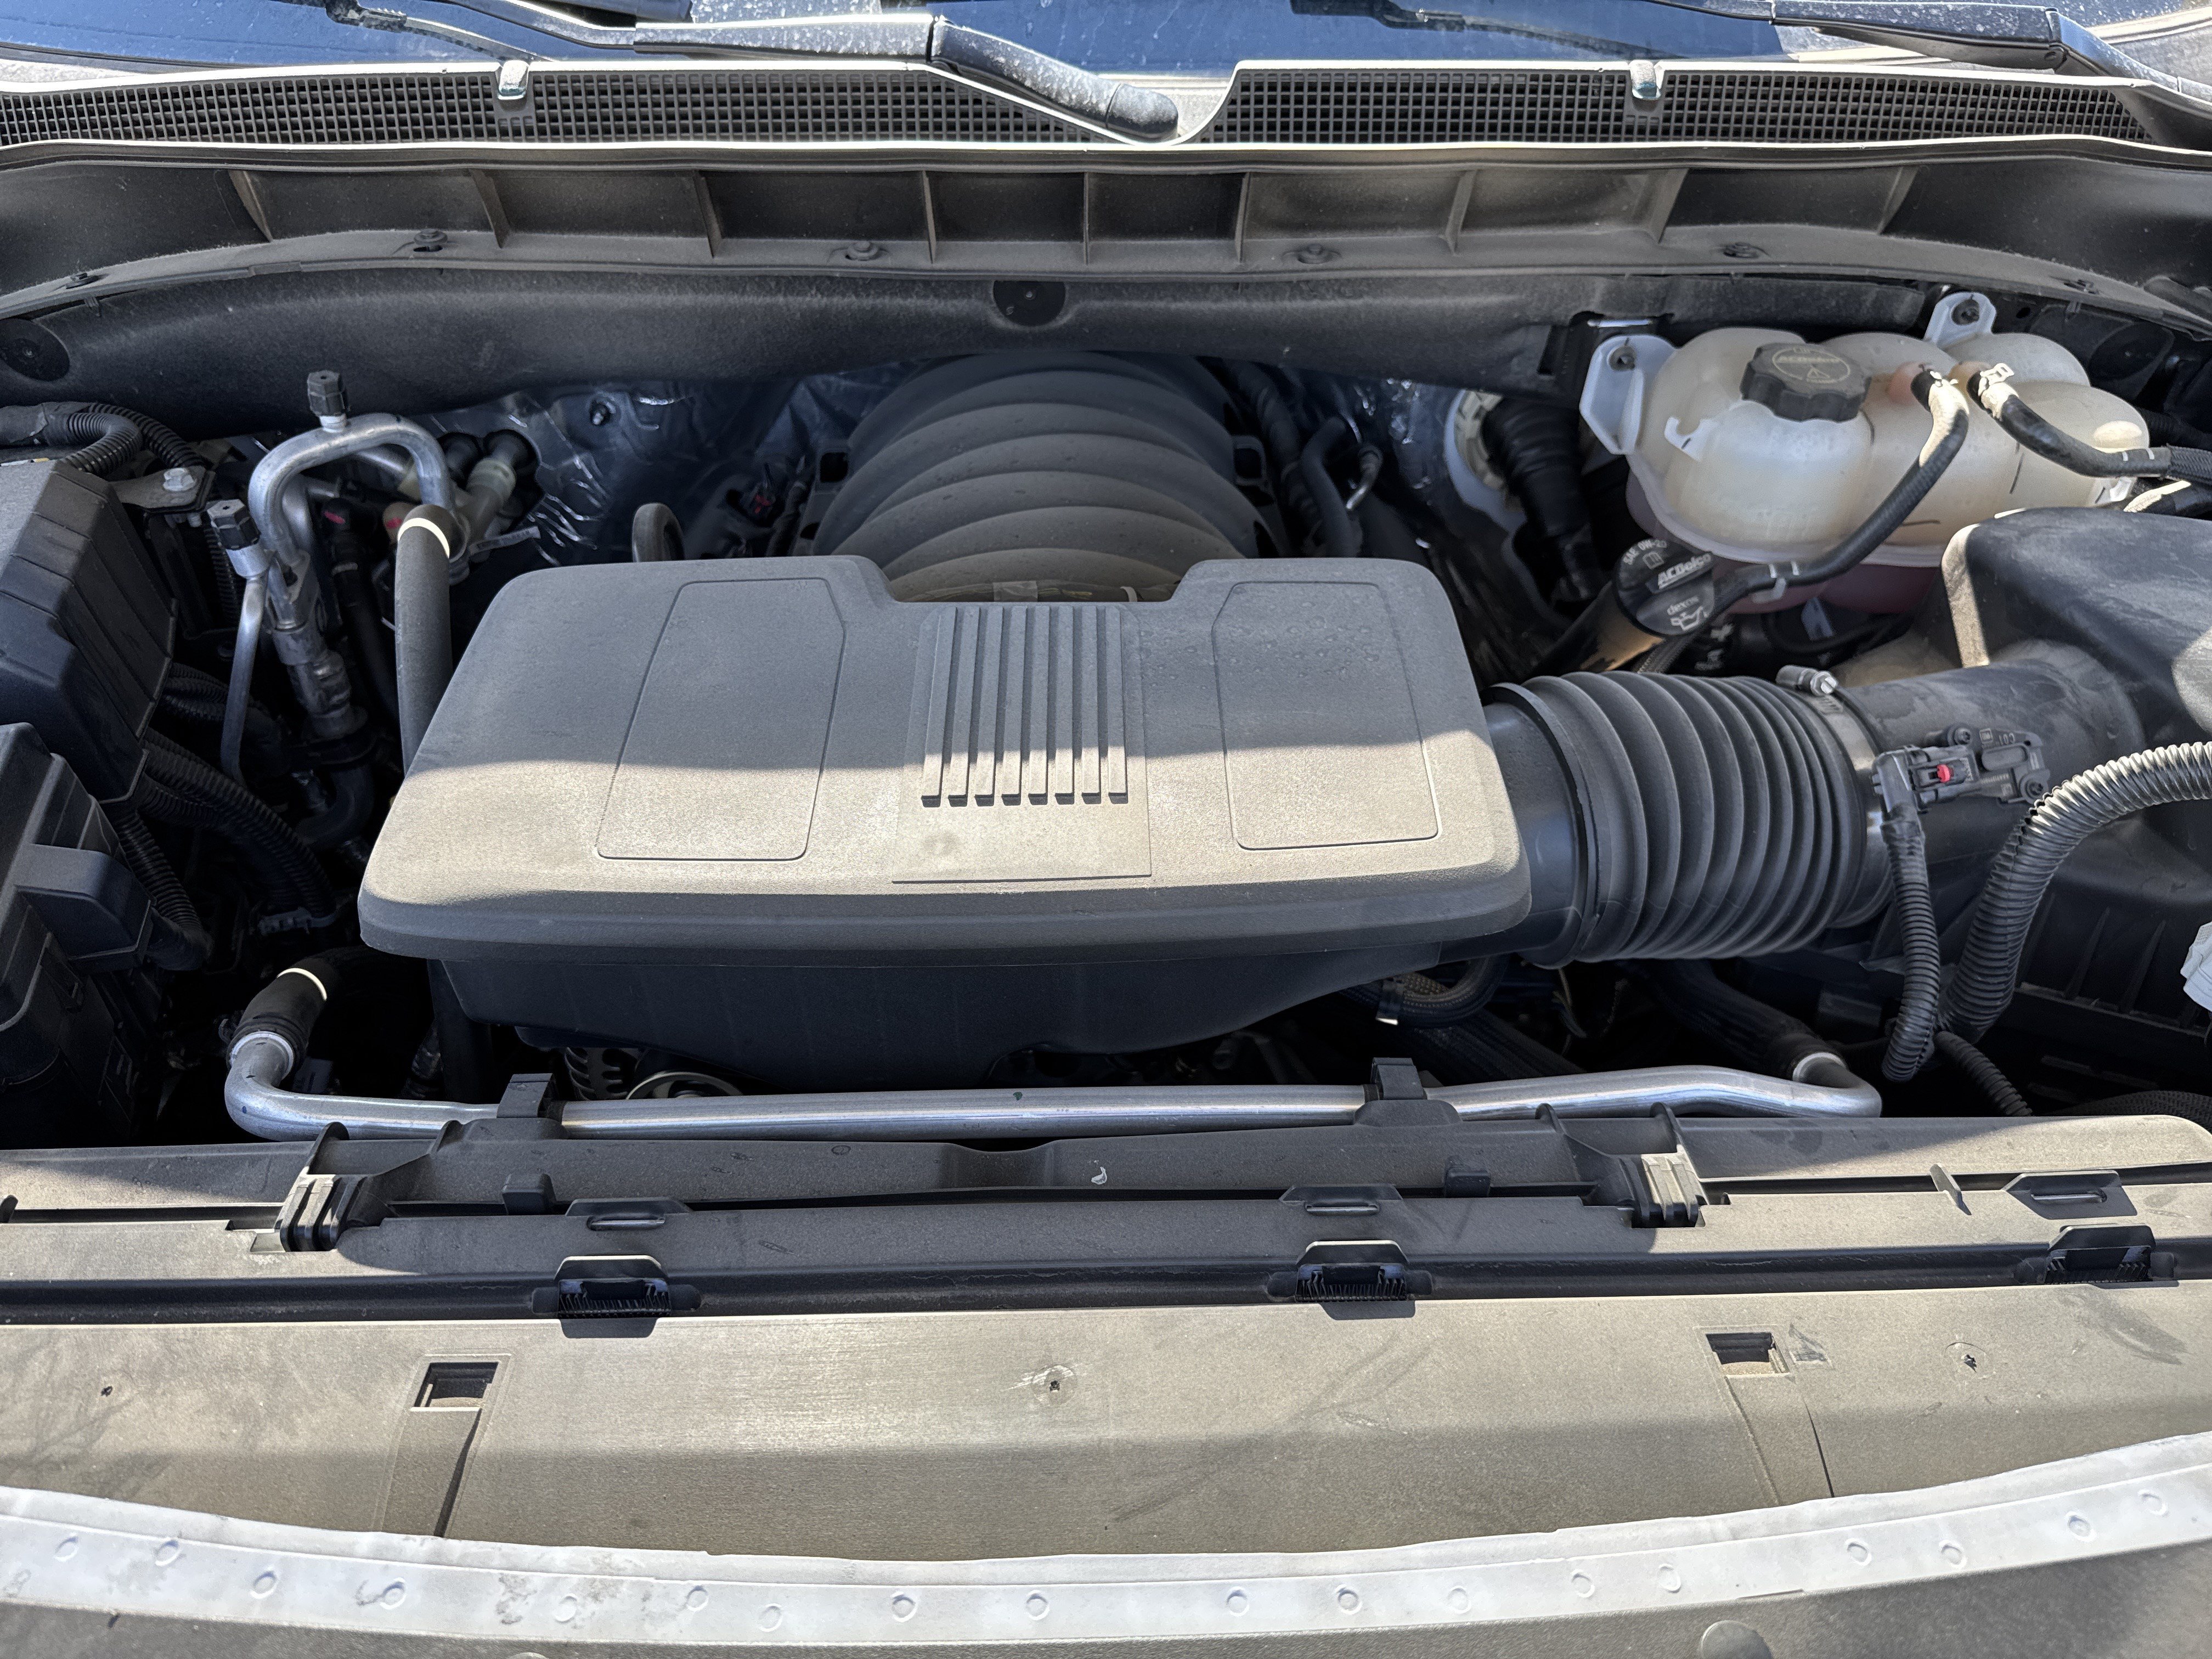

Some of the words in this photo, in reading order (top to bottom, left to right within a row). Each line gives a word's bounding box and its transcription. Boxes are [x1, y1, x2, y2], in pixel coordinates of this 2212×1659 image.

[1623, 546, 1639, 565] SAE
[1638, 539, 1668, 551] 0W-20
[1657, 552, 1712, 588] ACDelco
[1666, 595, 1700, 616] dexos
